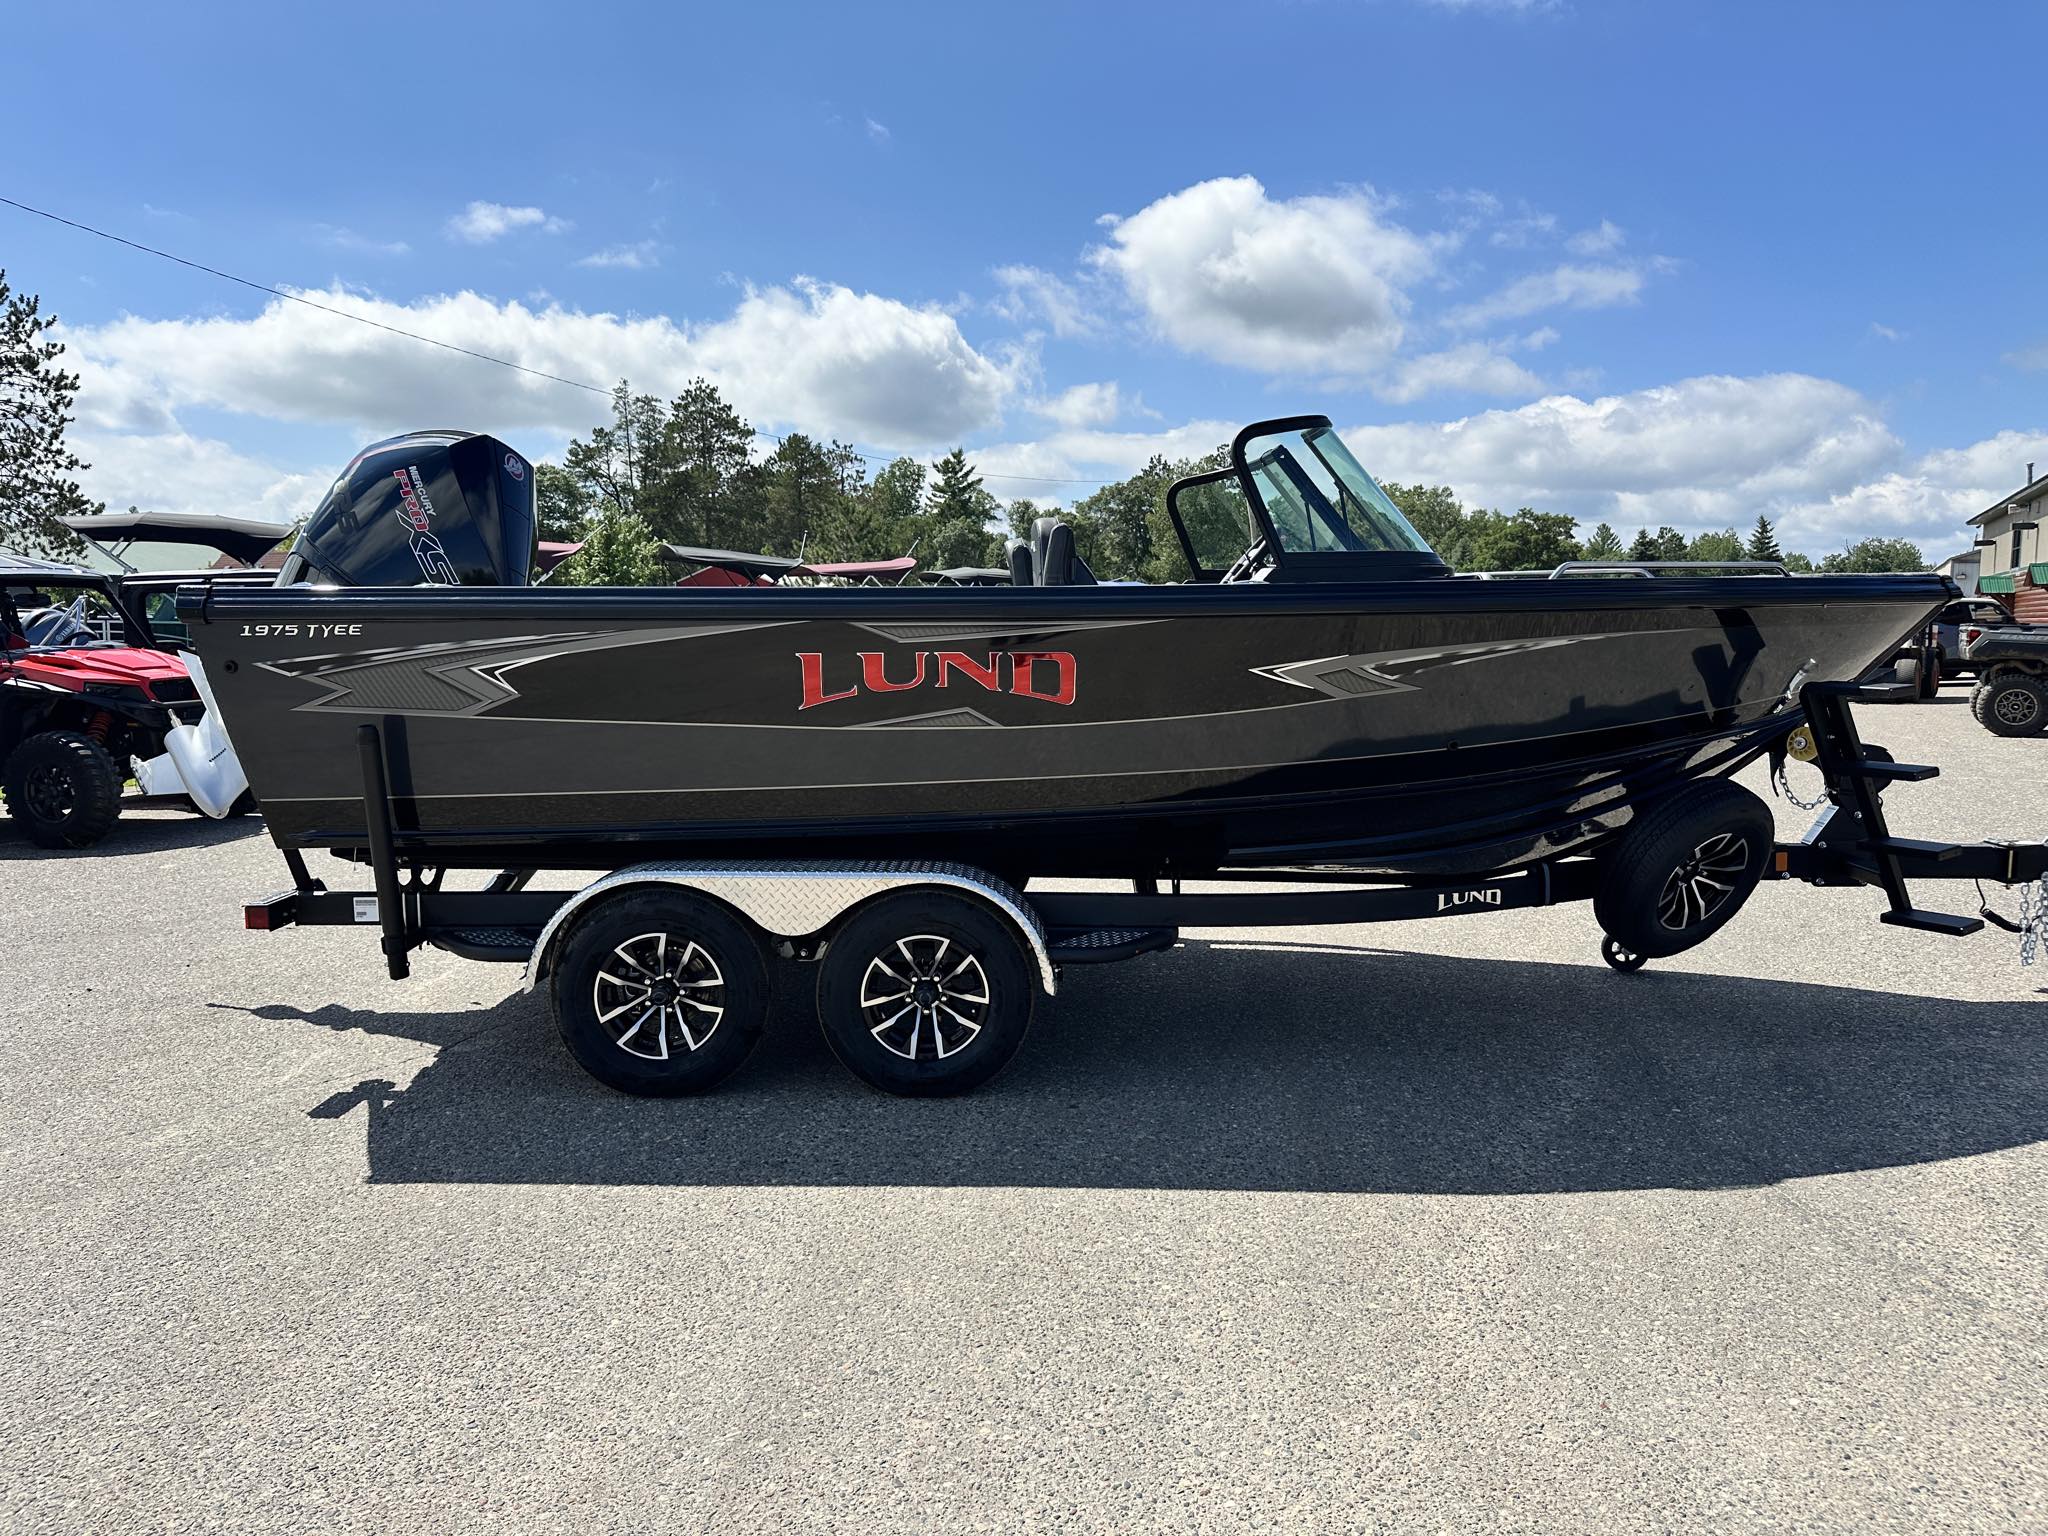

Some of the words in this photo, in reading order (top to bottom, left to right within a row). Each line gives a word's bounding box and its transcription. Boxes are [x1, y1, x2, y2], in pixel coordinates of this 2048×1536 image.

[393, 469, 429, 532] PRO
[408, 465, 437, 517] MERCURY
[240, 625, 299, 637] 1975
[306, 624, 363, 639] TYEE
[795, 651, 1077, 711] LUND
[1437, 888, 1502, 912] LUND
